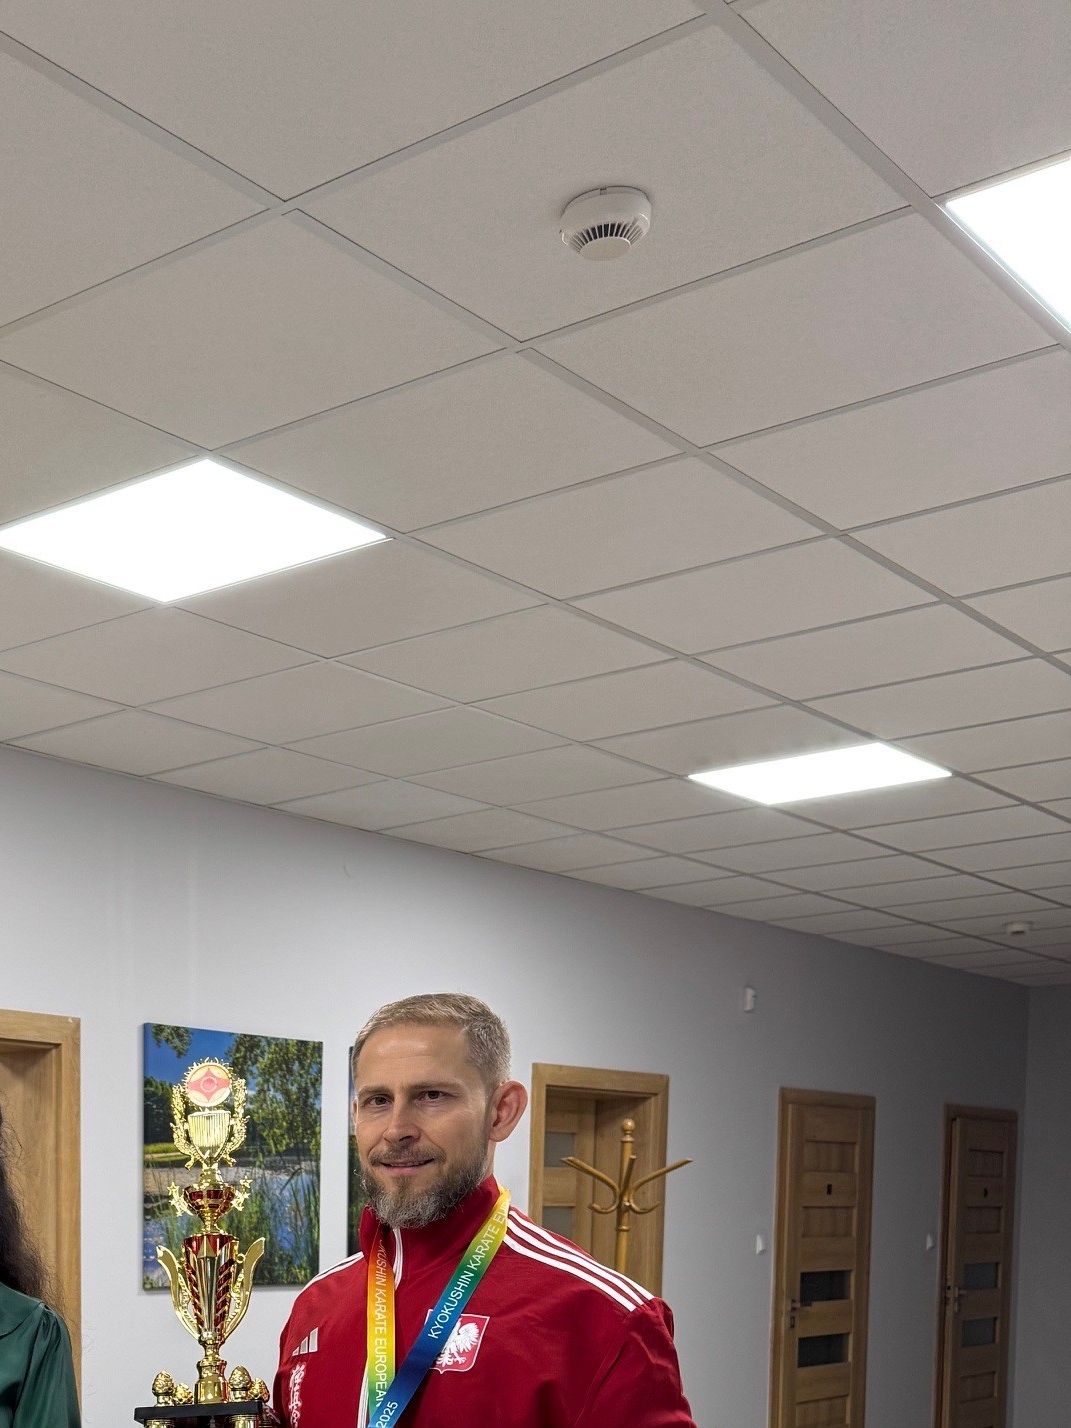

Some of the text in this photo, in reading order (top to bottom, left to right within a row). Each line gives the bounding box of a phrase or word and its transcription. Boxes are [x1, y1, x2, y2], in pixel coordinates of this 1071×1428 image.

[374, 1288, 387, 1335] KARATE
[427, 1270, 475, 1339] KYOKUSHIN
[466, 1223, 500, 1271] KARATE
